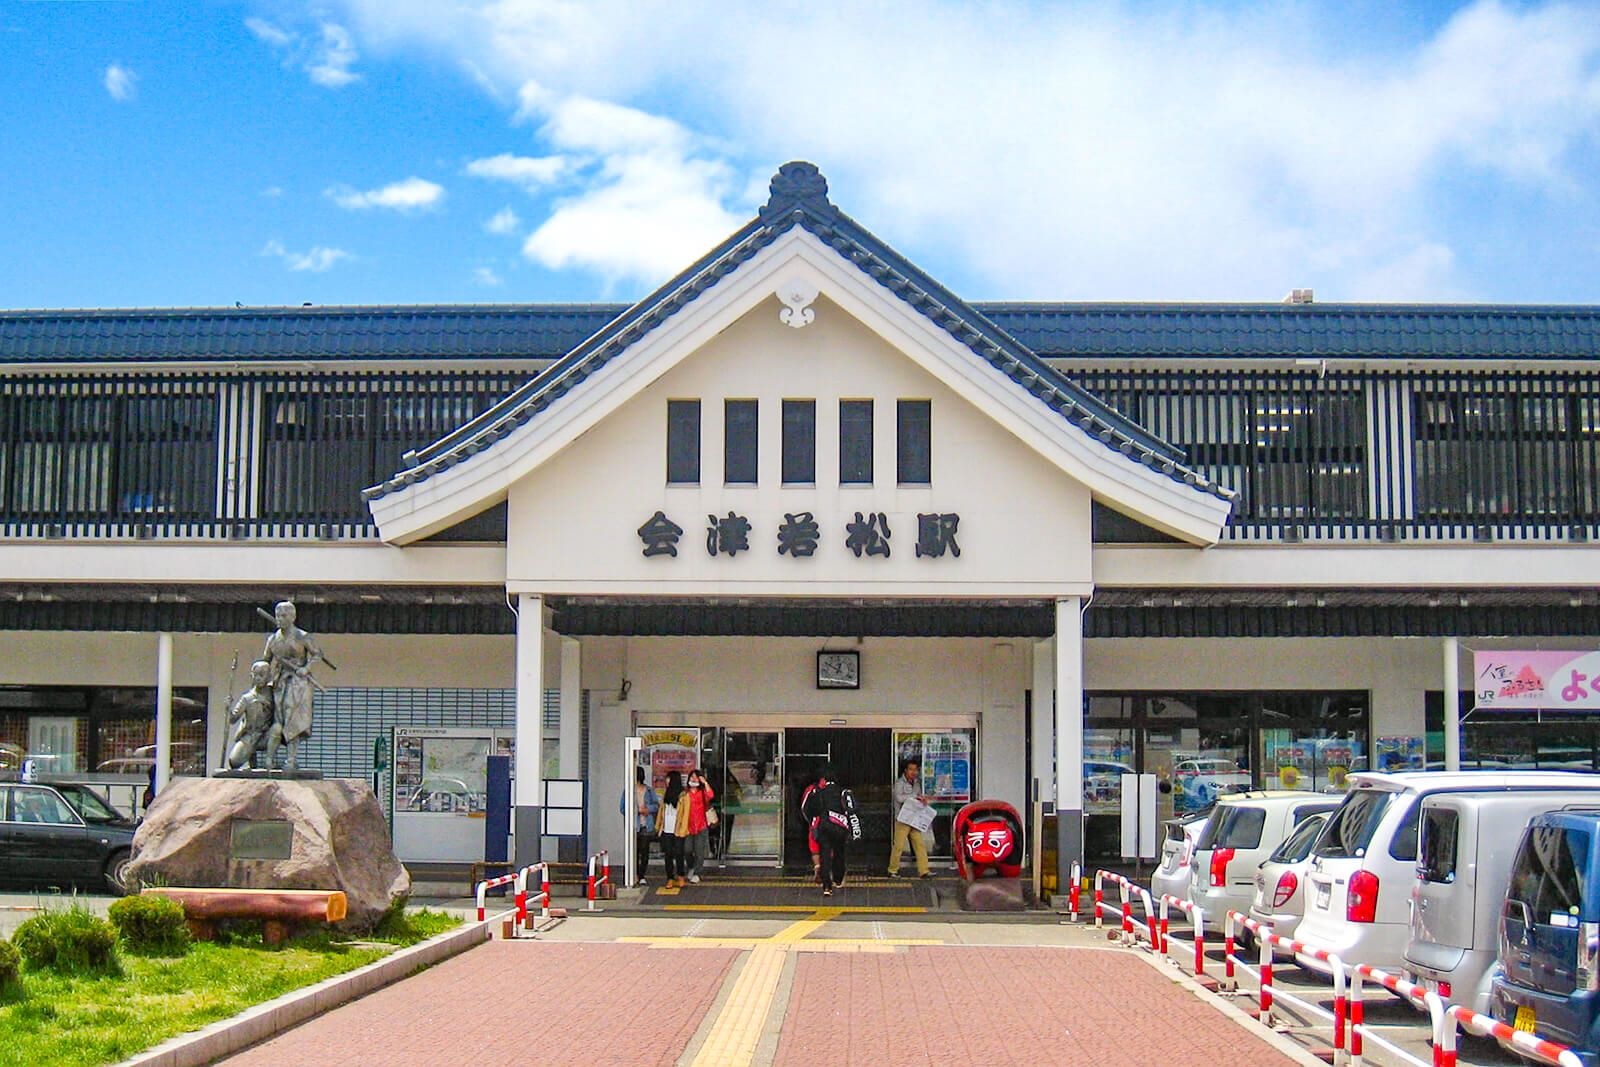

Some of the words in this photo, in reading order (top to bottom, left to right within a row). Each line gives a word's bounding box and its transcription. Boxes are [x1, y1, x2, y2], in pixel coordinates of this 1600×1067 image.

[637, 511, 960, 557] 会津若松駅
[1478, 690, 1495, 700] JR
